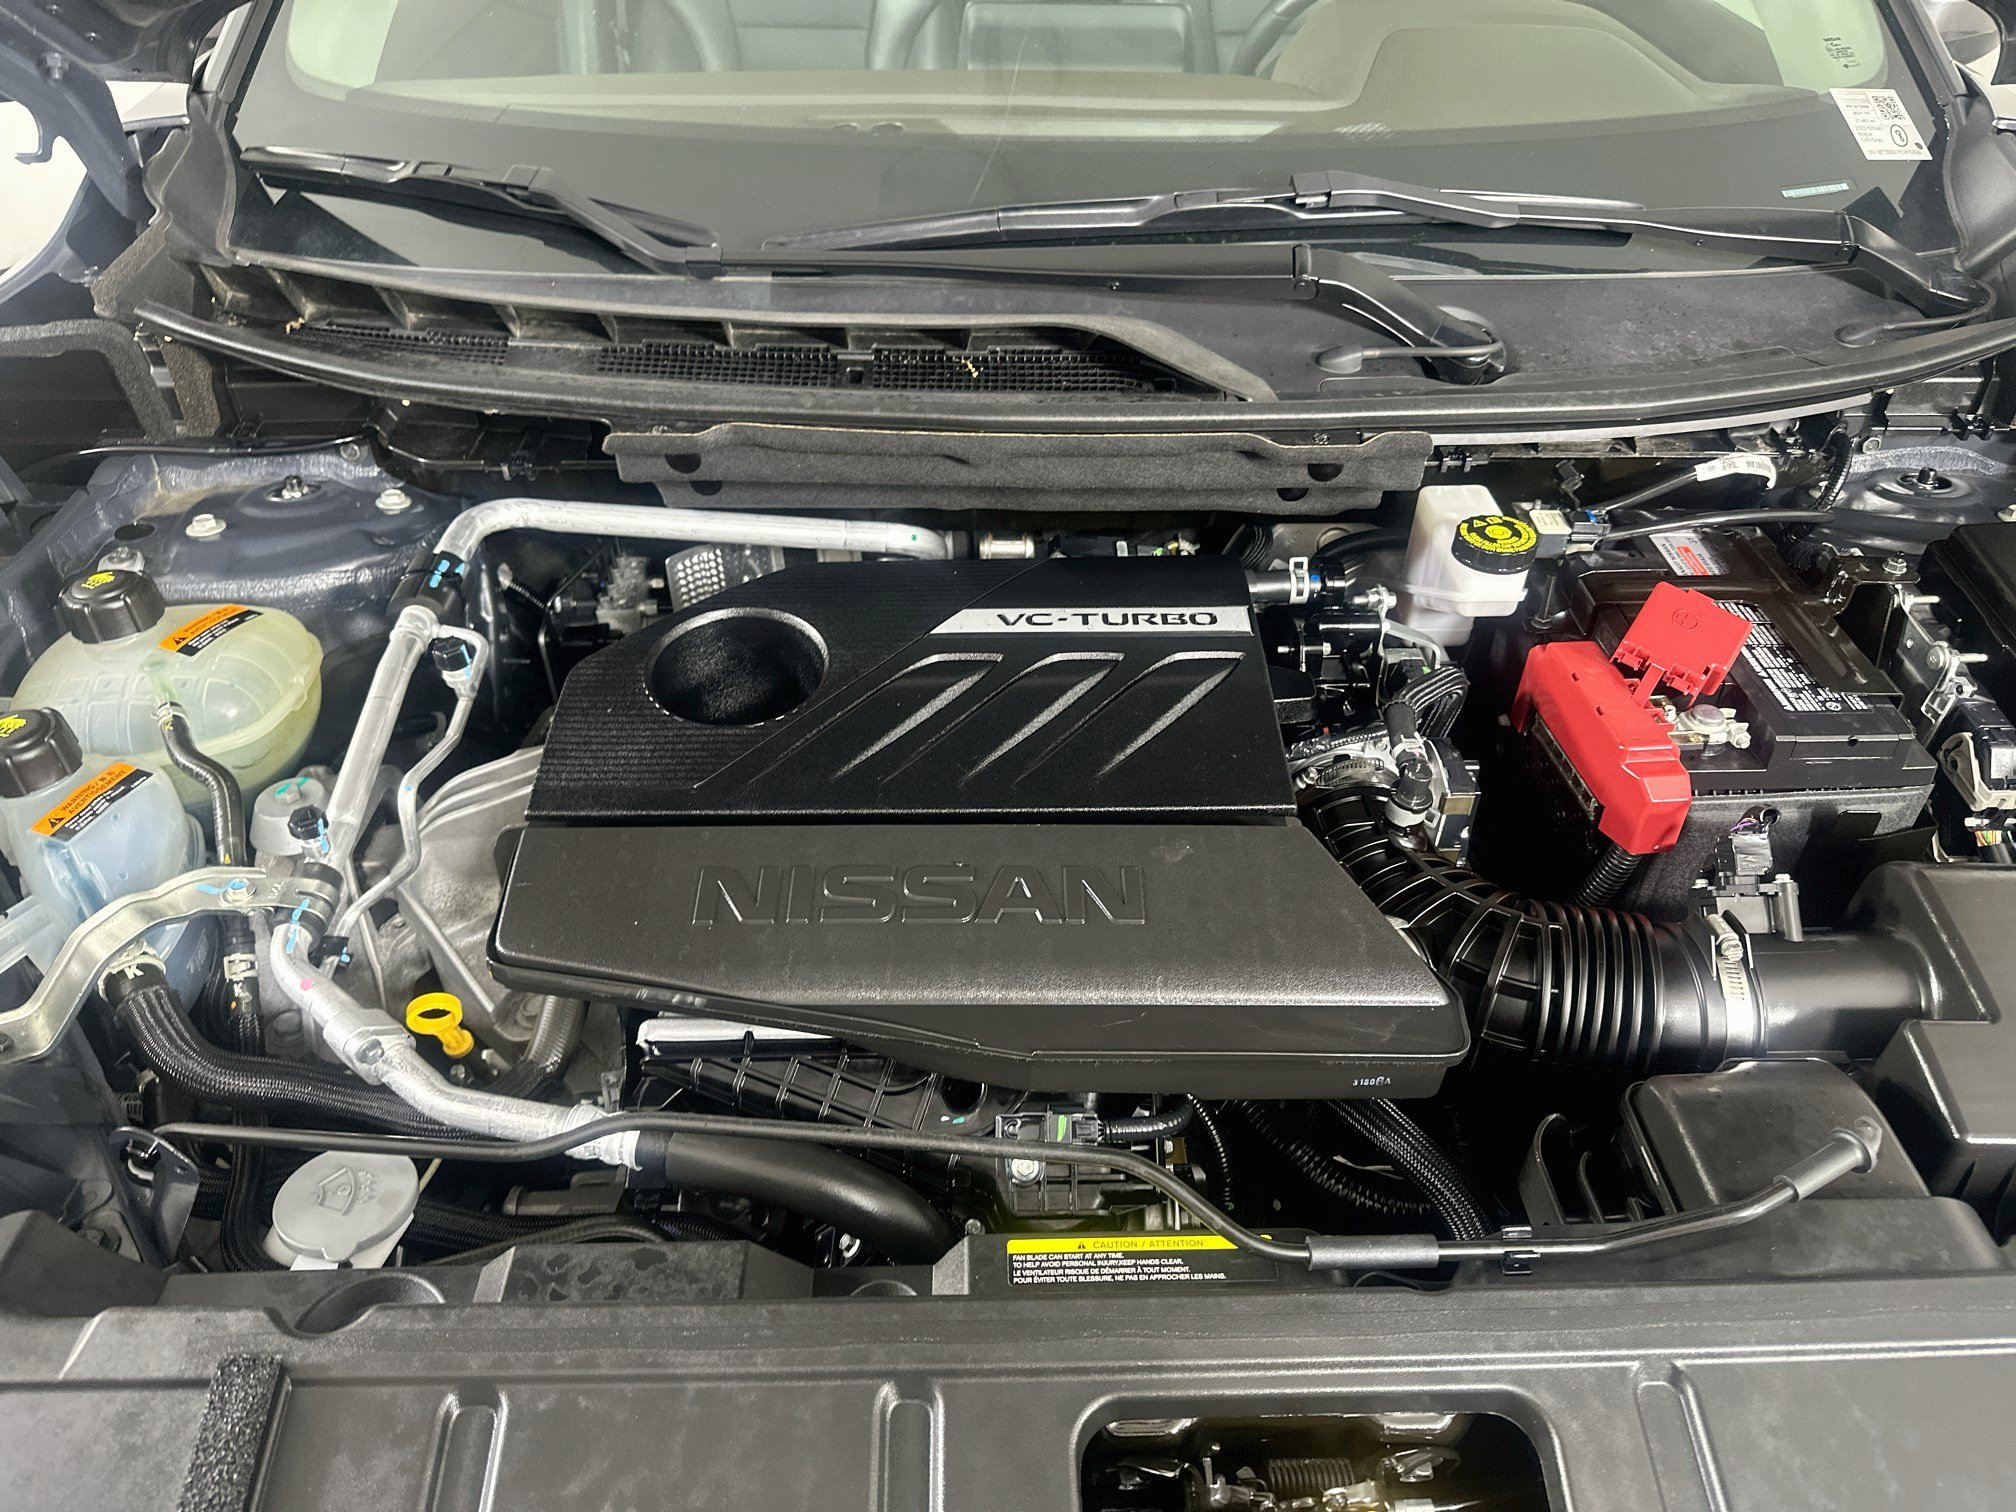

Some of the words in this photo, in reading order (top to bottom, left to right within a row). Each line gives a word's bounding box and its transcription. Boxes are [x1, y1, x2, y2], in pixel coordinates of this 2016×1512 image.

[997, 612, 1218, 626] VC-TURBO
[60, 784, 95, 812] WARNING
[69, 770, 126, 814] AVERTISSEMENT
[692, 864, 1146, 925] NISSAN
